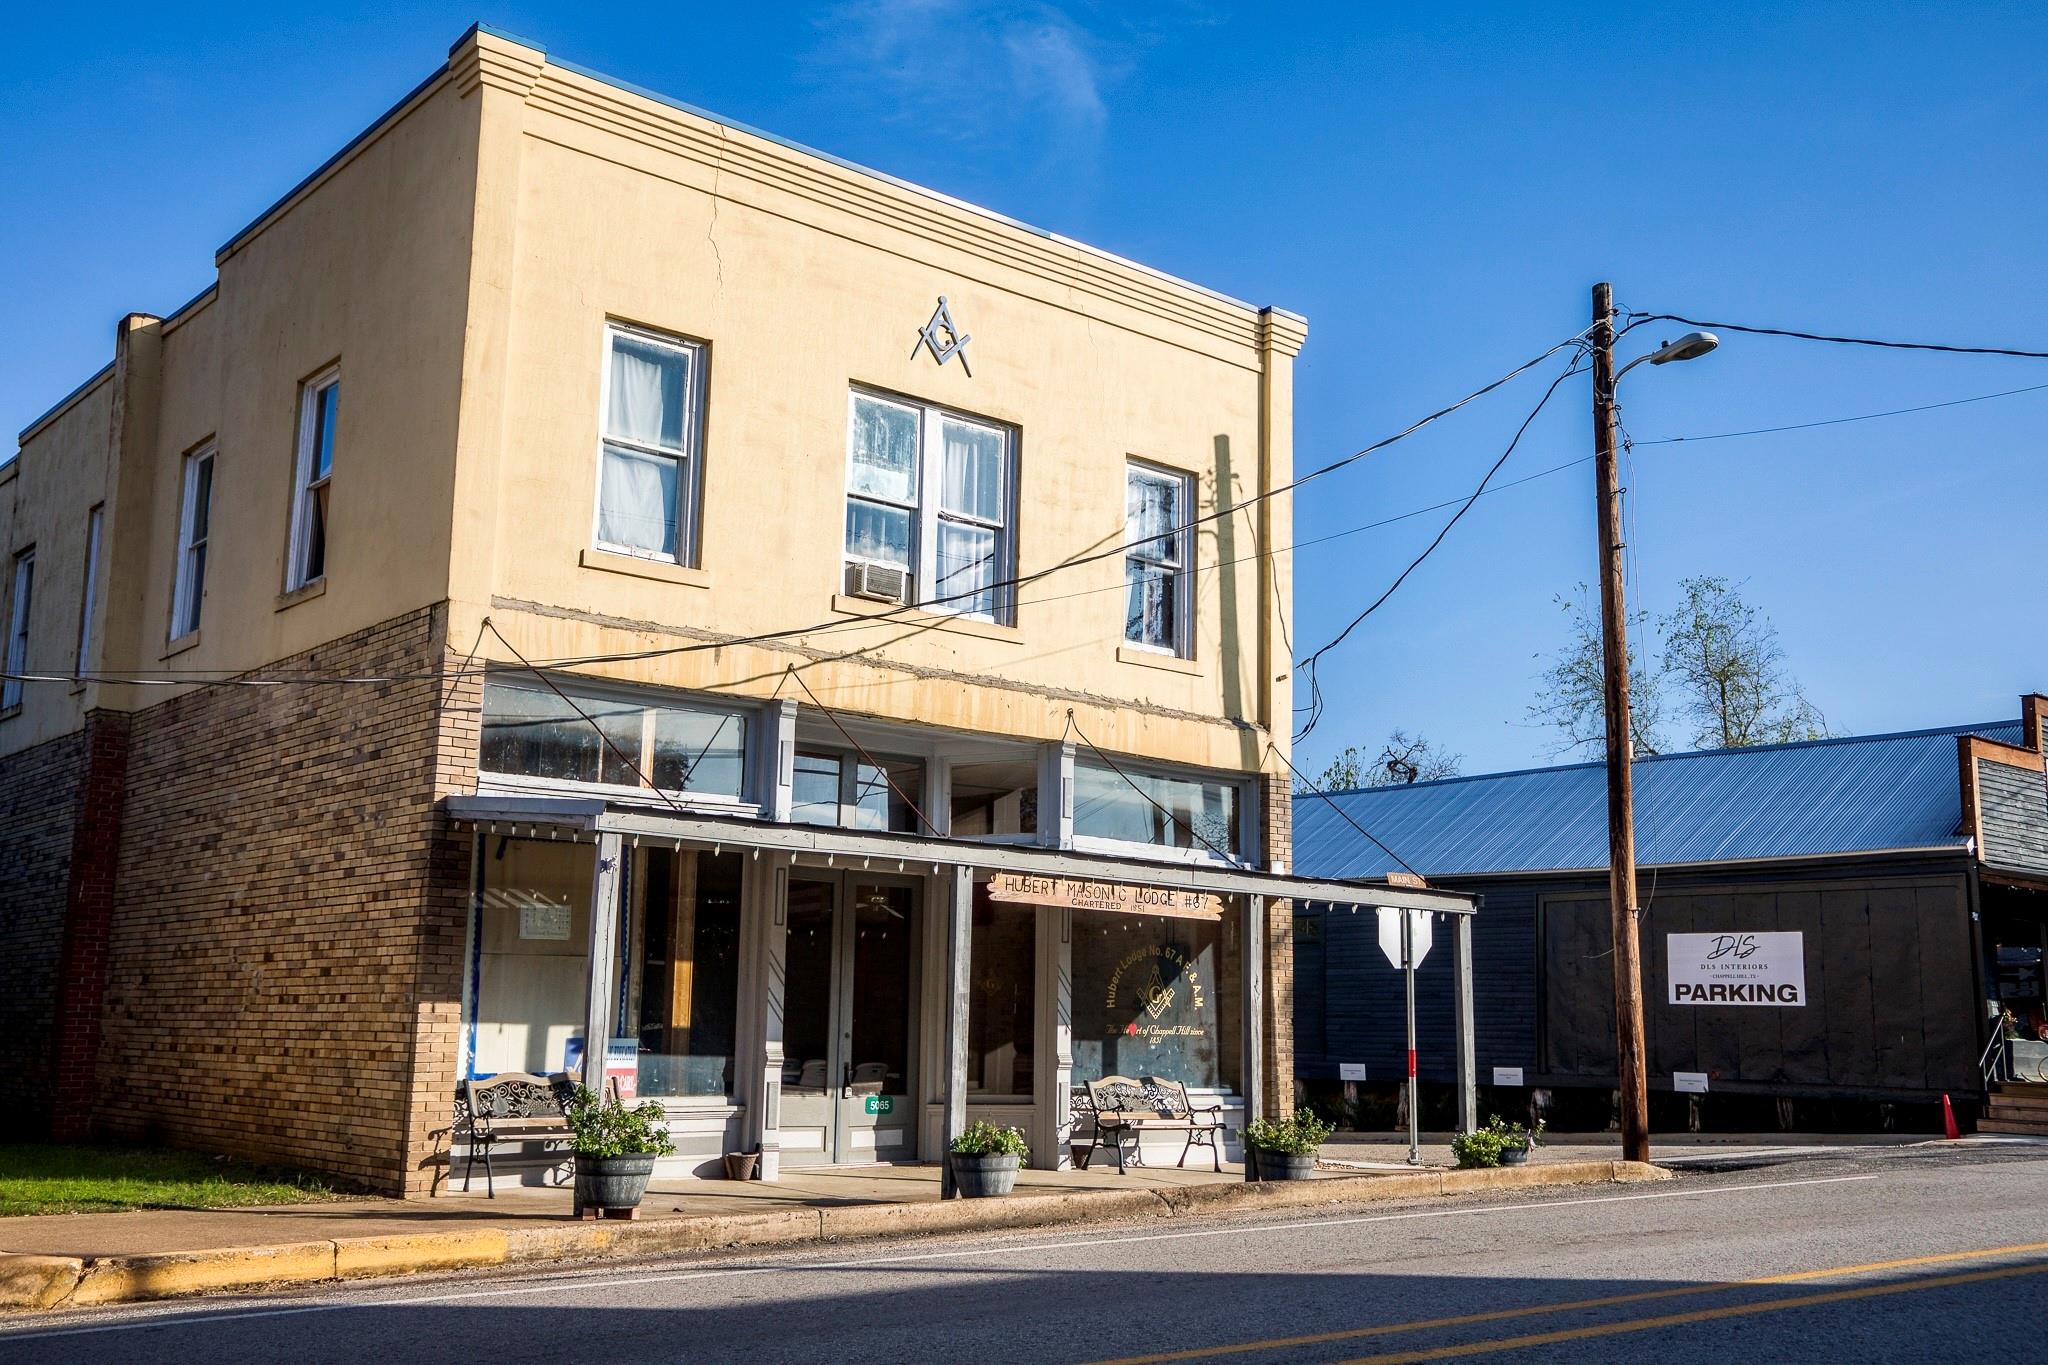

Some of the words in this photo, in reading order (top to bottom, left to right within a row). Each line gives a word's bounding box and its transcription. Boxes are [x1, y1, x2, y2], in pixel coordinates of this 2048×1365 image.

[1391, 875, 1411, 884] MAIN
[1005, 877, 1057, 896] HUBERT
[1067, 882, 1126, 902] MASONIC
[1135, 889, 1175, 907] LODGE
[1185, 894, 1209, 910] #67
[1071, 897, 1122, 910] CHARTERED
[1707, 934, 1760, 960] DLS
[1106, 967, 1124, 1008] Hubert
[1120, 948, 1147, 969] Lodge
[1149, 944, 1163, 957] No.
[1165, 946, 1176, 960] 67
[1192, 985, 1204, 1010] A.M.
[1675, 983, 1798, 1003] PARKING
[1143, 1024, 1150, 1037] of
[1149, 1024, 1177, 1037] Chappell
[1176, 1025, 1191, 1036] Hill
[1190, 1027, 1205, 1036] since
[870, 1100, 890, 1111] 5065
